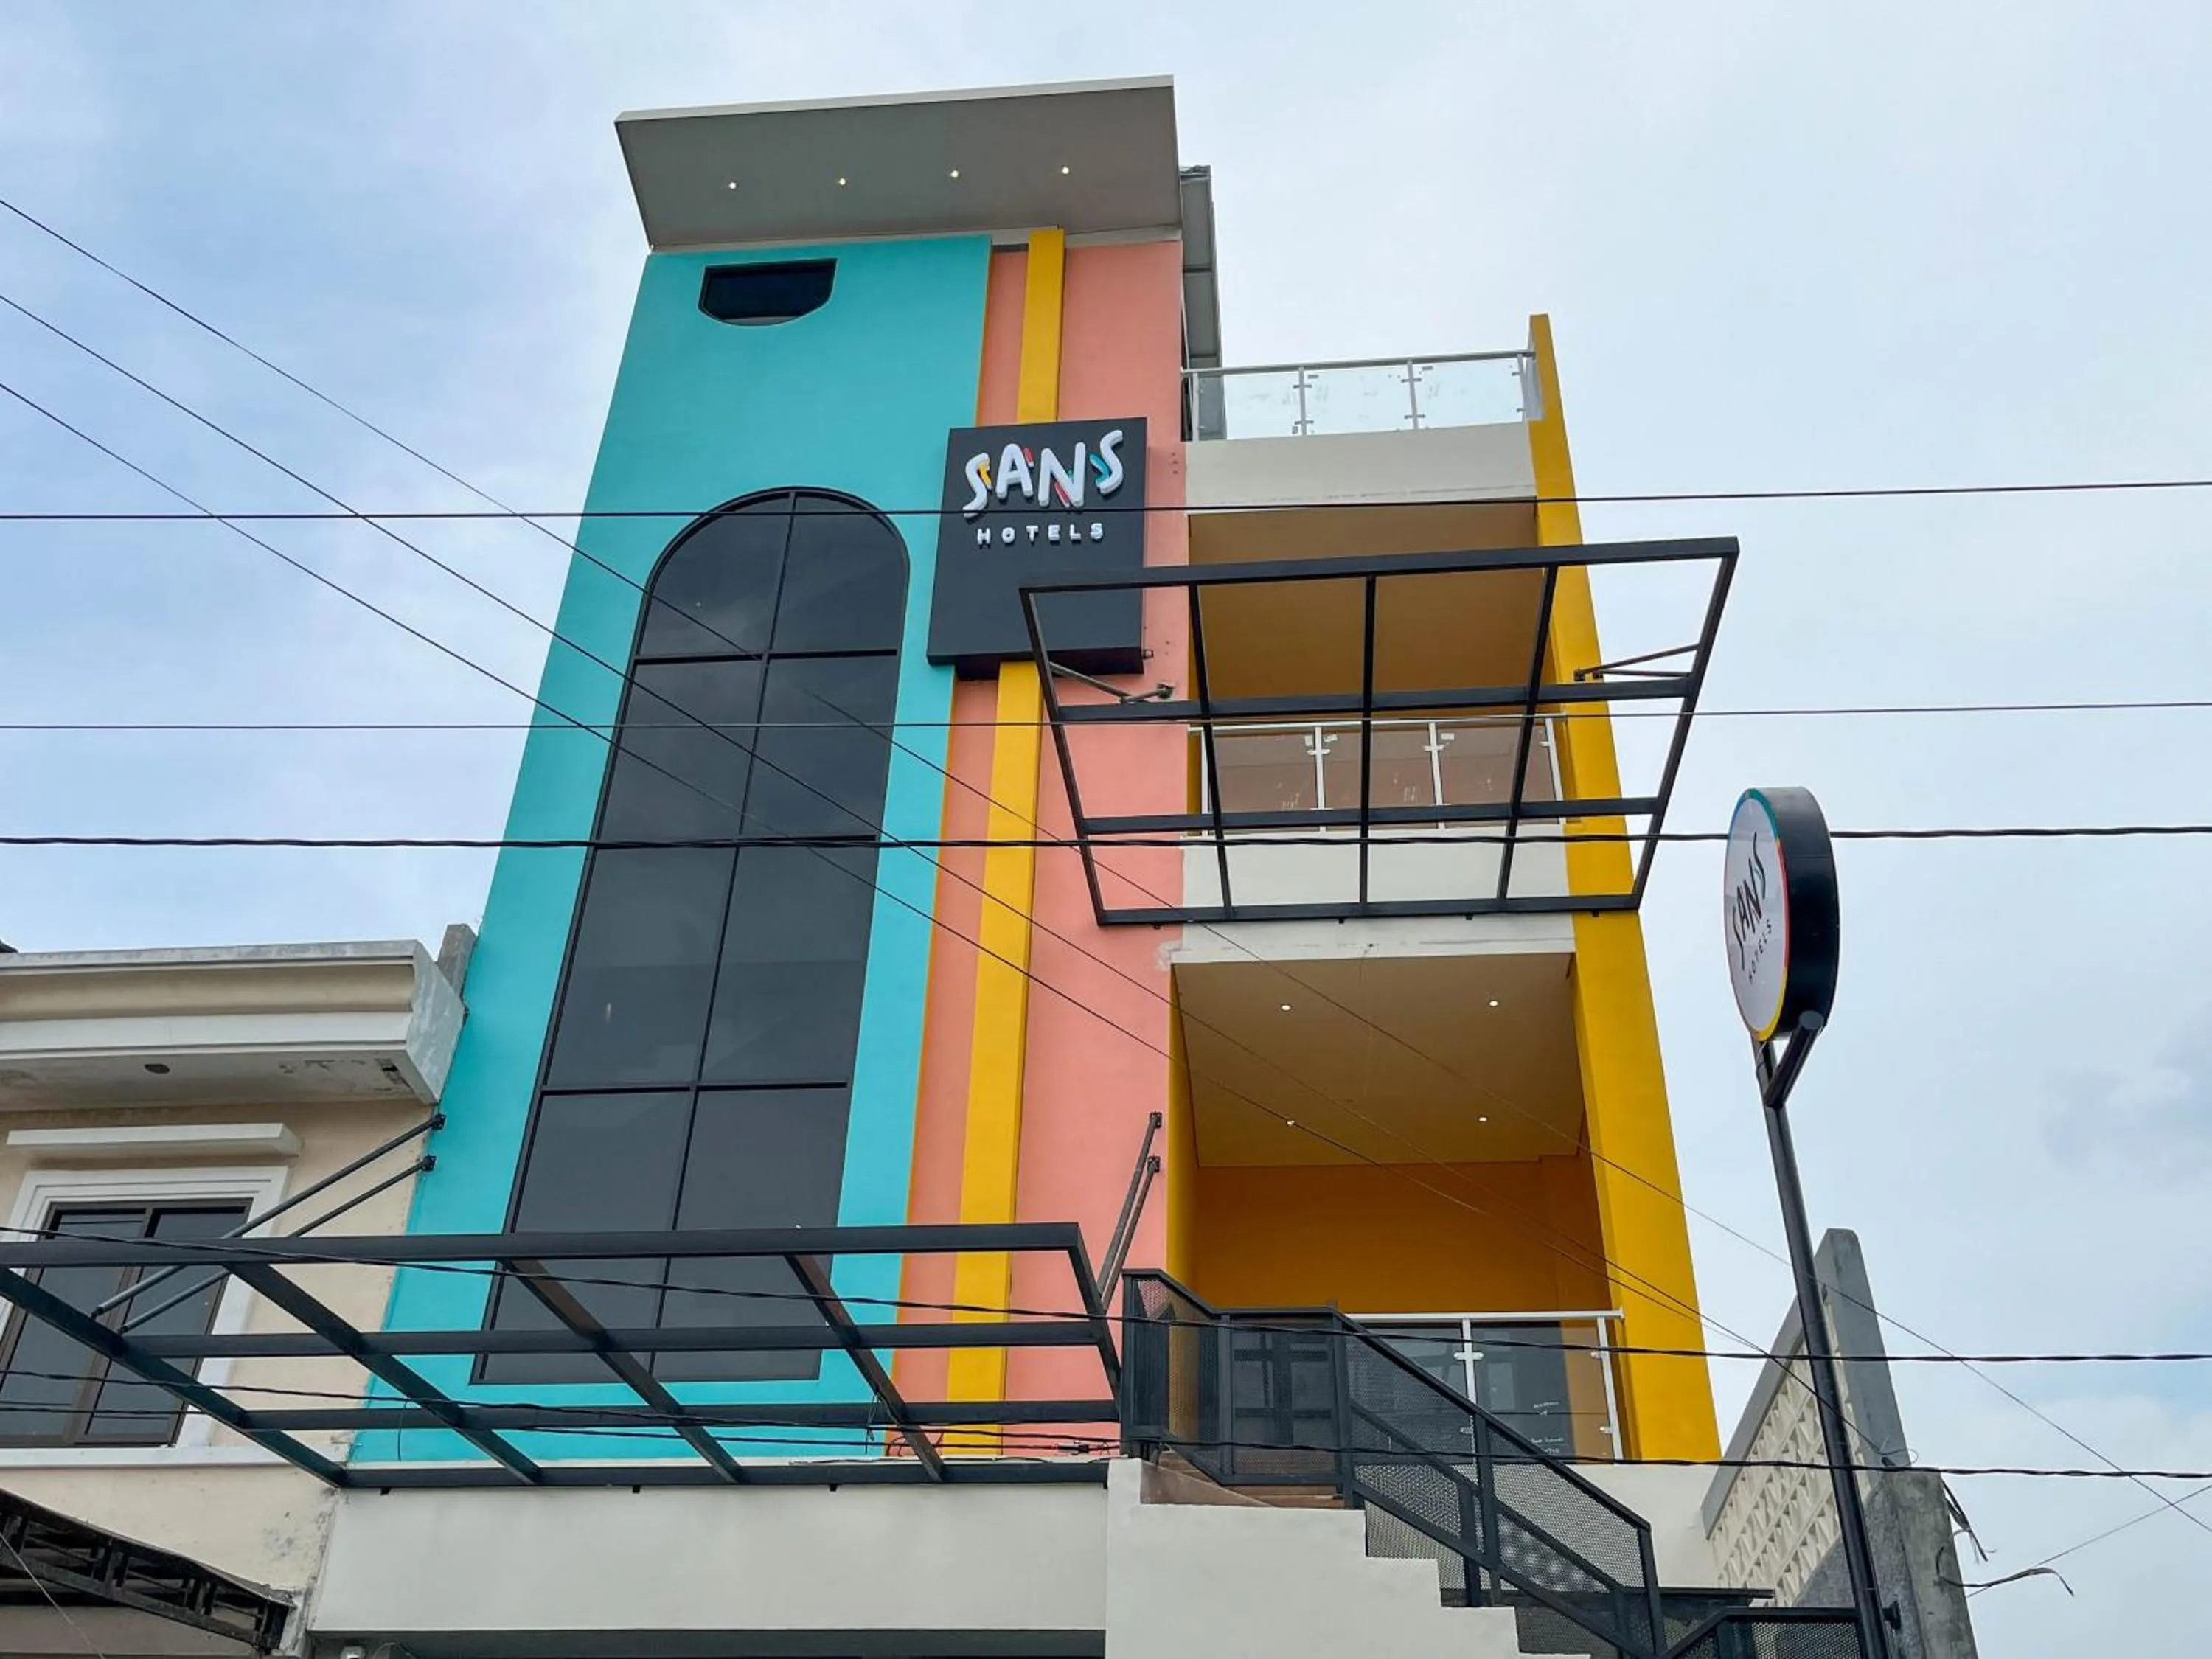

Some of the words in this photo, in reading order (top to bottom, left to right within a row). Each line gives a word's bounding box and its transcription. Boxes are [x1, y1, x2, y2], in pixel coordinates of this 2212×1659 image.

[962, 429, 1124, 517] SANS
[976, 523, 1104, 546] HOTELS
[1732, 831, 1766, 971] SANS
